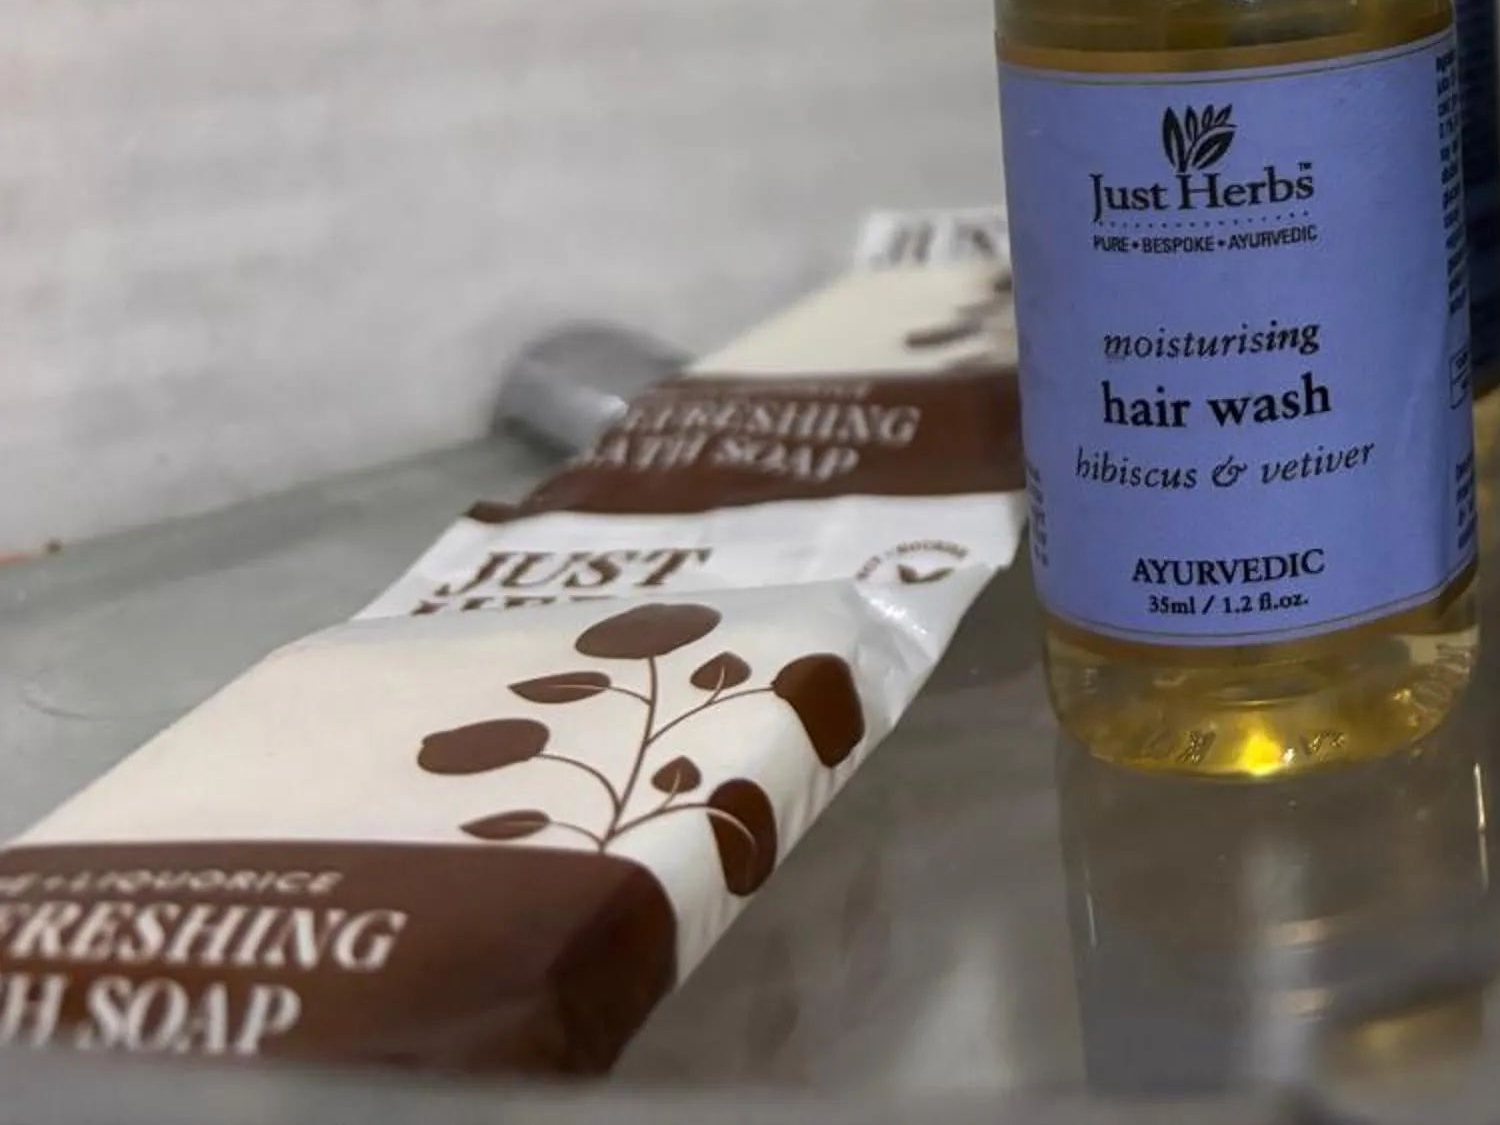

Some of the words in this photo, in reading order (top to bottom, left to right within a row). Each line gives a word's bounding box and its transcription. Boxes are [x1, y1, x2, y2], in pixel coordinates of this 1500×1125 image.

[1089, 172, 1169, 223] Just
[1093, 234, 1129, 253] PURE
[1141, 235, 1215, 254] BESPOKE
[1227, 224, 1319, 251] AYURVEDIC
[1103, 319, 1320, 359] moisturising
[1101, 380, 1191, 428] hair
[1207, 371, 1331, 427] wash
[1075, 446, 1198, 489] hibiscus
[1211, 455, 1248, 488] &
[1261, 442, 1375, 485] vetiver
[433, 548, 714, 597] JUST
[1131, 548, 1325, 586] AYURVEDIC
[1149, 594, 1196, 615] 35ml
[1223, 595, 1253, 614] 1.2
[72, 973, 302, 1055] SOAP
